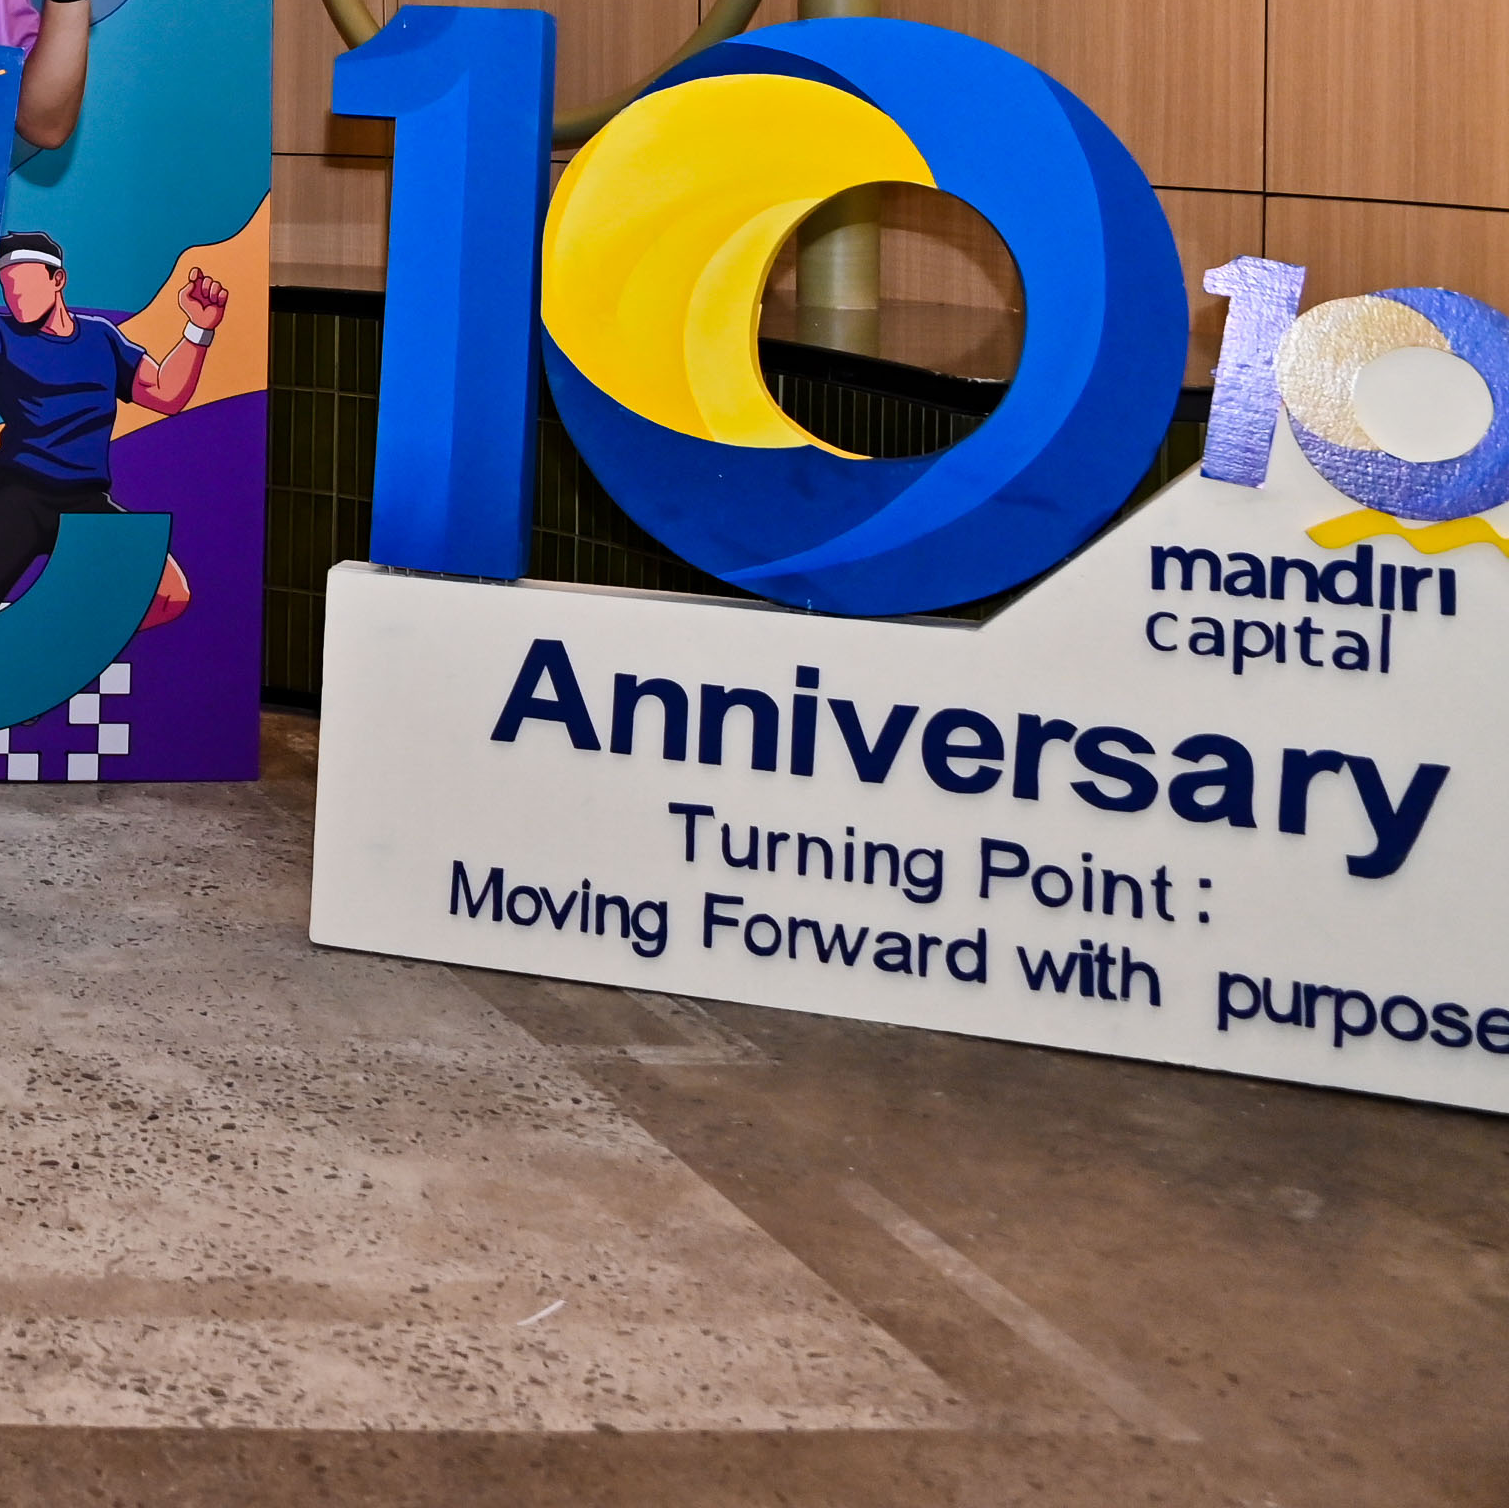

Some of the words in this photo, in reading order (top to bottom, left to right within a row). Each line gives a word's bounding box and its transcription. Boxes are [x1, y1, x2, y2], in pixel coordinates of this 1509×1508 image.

[331, 4, 1189, 617] 10
[1202, 254, 1509, 522] 10
[1147, 609, 1392, 676] capital
[1150, 545, 1457, 616] mandiri
[490, 638, 1451, 878] Anniversary
[669, 803, 945, 903] Turning
[449, 860, 669, 957] Moving
[703, 897, 987, 985] Forward
[1016, 939, 1161, 1006] with
[1217, 969, 1509, 1055] purpose
